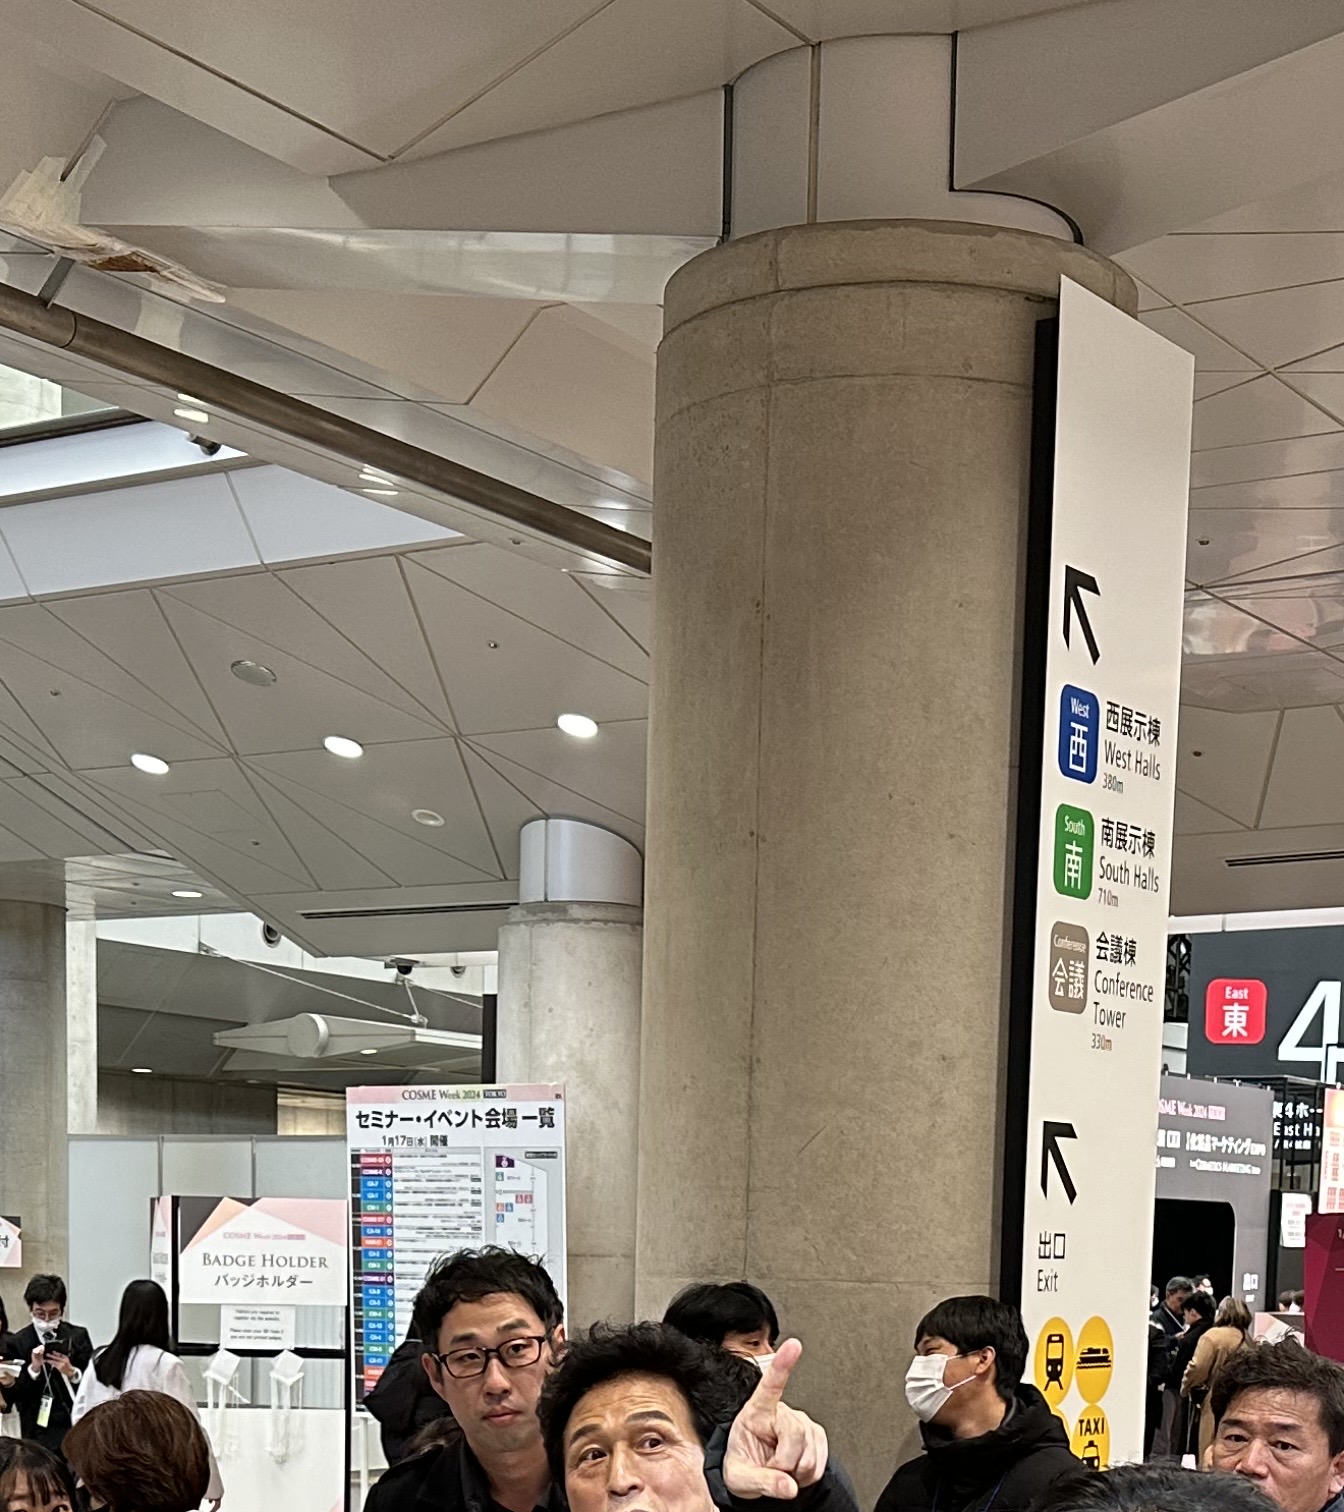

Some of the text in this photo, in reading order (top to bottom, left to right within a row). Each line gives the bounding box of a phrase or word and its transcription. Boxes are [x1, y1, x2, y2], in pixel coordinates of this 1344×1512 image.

[1070, 697, 1090, 719] West
[1106, 701, 1161, 747] 西展示棟
[1069, 722, 1088, 773] 西
[1104, 739, 1161, 780] West Halls
[1102, 772, 1123, 794] 380m
[1064, 814, 1085, 836] South
[1101, 817, 1156, 859] 南展示棟
[1064, 840, 1083, 889] 南
[1099, 855, 1159, 893] South Halls
[1098, 887, 1119, 907] 710m
[1096, 931, 1137, 967] 会議棟
[1052, 957, 1085, 999] 会議
[1094, 970, 1154, 1002] Conference
[1225, 986, 1249, 1000] East
[1093, 1001, 1126, 1028] Tower
[1221, 1002, 1250, 1038] 東
[1091, 1032, 1112, 1051] 330m
[402, 1089, 436, 1101] COSME
[439, 1089, 461, 1100] Week
[462, 1089, 481, 1100] 2024
[1038, 1230, 1066, 1259] 出口
[202, 1252, 329, 1268] BADGE HOLDER
[214, 1274, 313, 1288] バッジホルダー
[1037, 1268, 1059, 1293] Exit
[1078, 1416, 1105, 1437] TAXI
